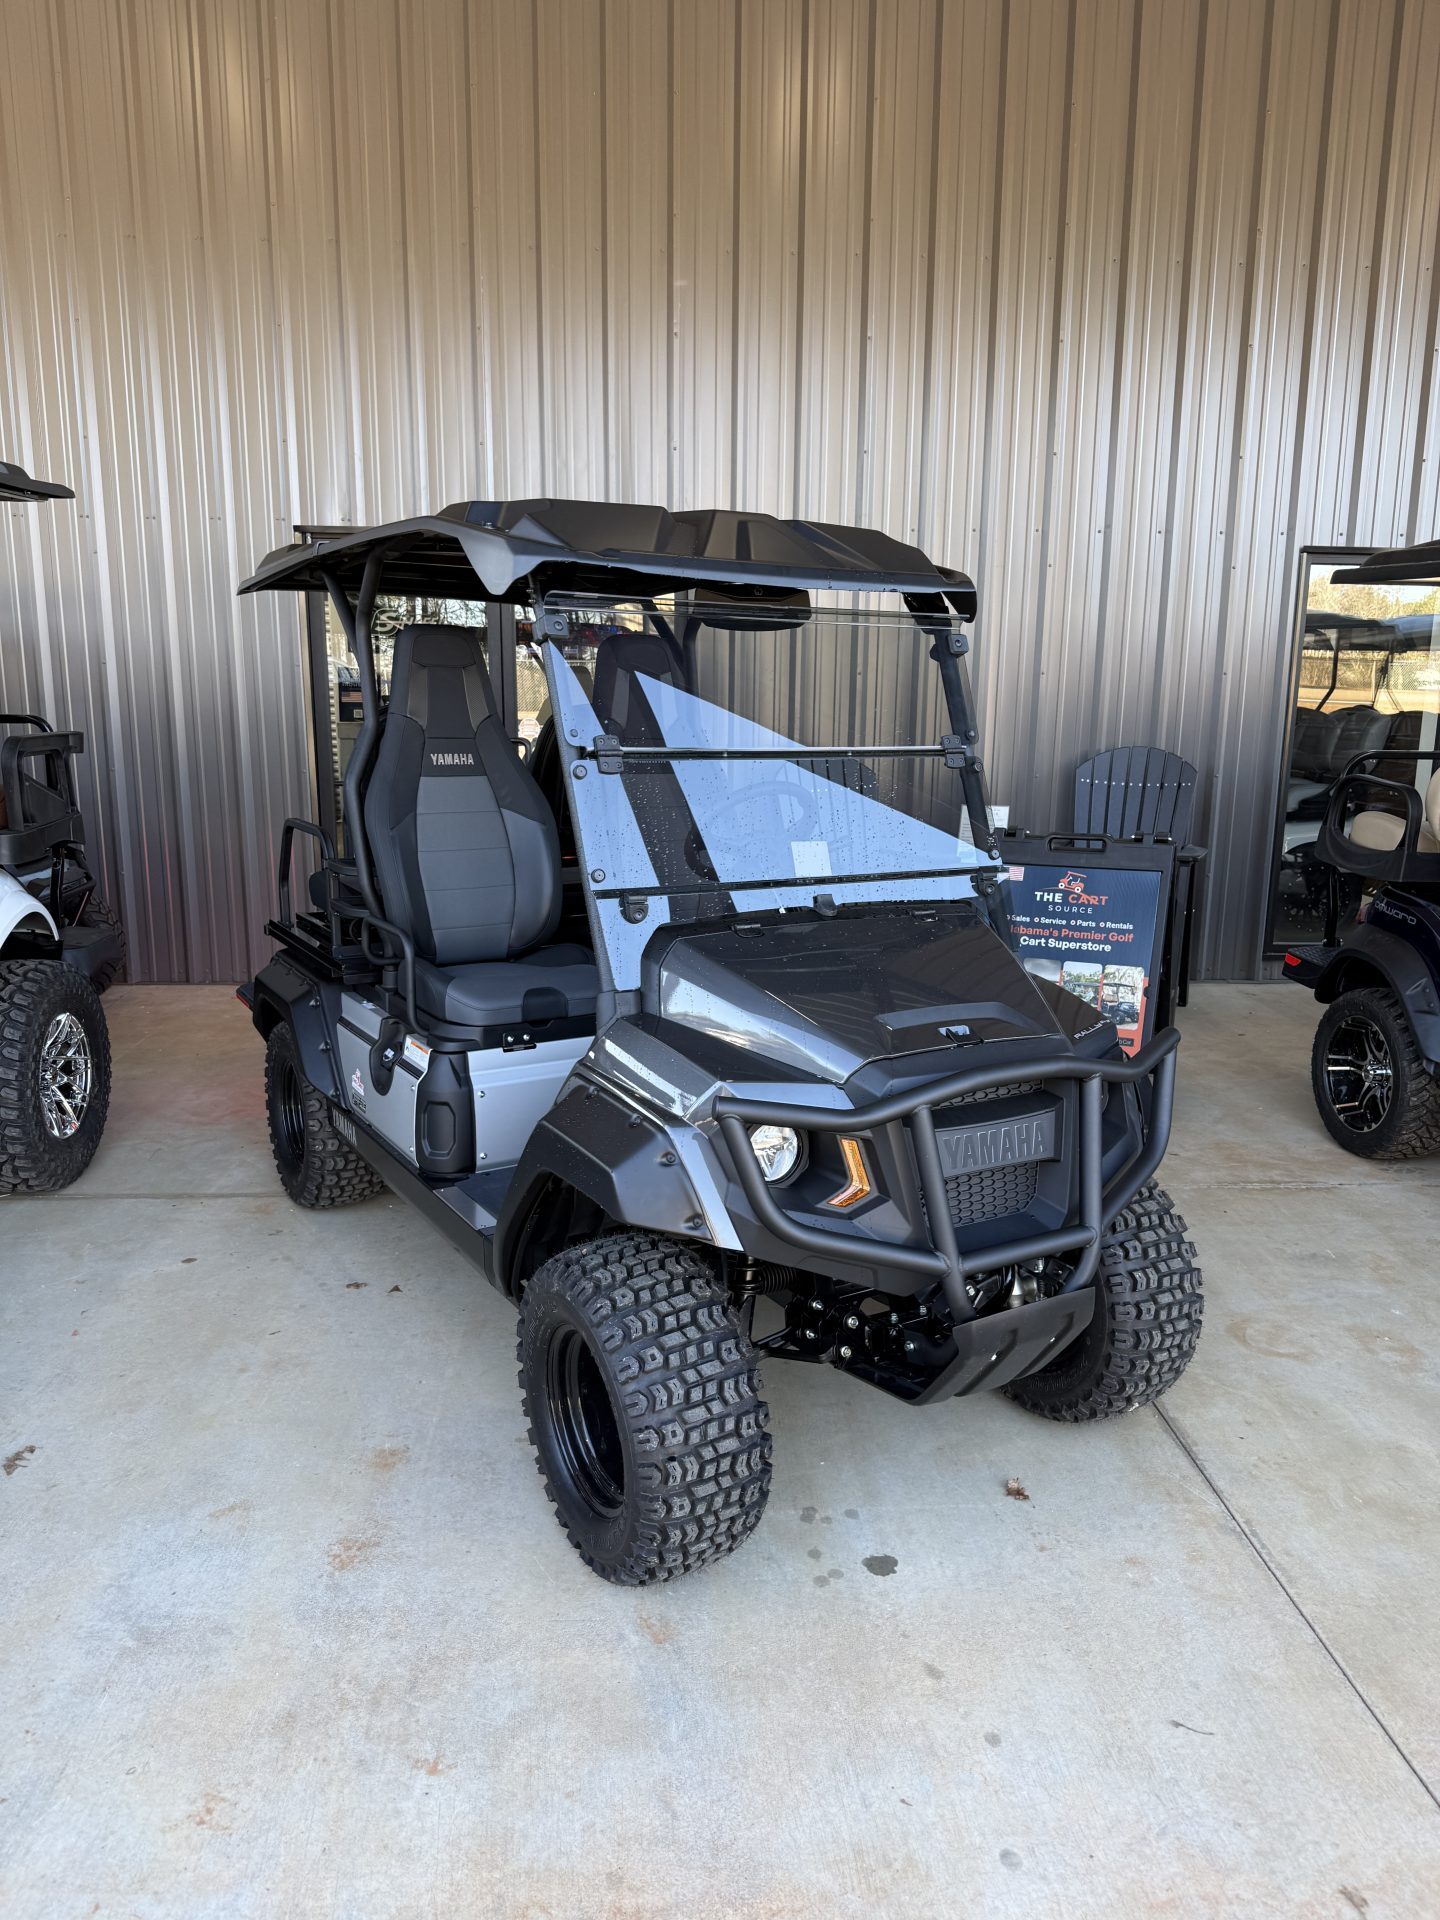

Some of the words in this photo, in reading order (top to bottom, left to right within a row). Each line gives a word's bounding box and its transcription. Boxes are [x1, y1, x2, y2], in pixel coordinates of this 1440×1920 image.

[430, 753, 475, 766] YAMAHA
[1034, 891, 1063, 903] THE
[1068, 894, 1109, 906] CART
[1047, 904, 1093, 914] SOURCE
[1011, 914, 1031, 923] Sales
[1040, 916, 1067, 926] Service
[1076, 919, 1097, 928] Parts
[1106, 921, 1134, 930] Rentals
[1009, 924, 1059, 937] labama's
[1060, 928, 1108, 940] Premier
[1108, 931, 1134, 943] Golf
[1019, 935, 1046, 946] Cart
[1047, 938, 1112, 952] Superstore
[331, 1105, 358, 1147] YAMAHA
[942, 1120, 1048, 1170] YAMAHA
